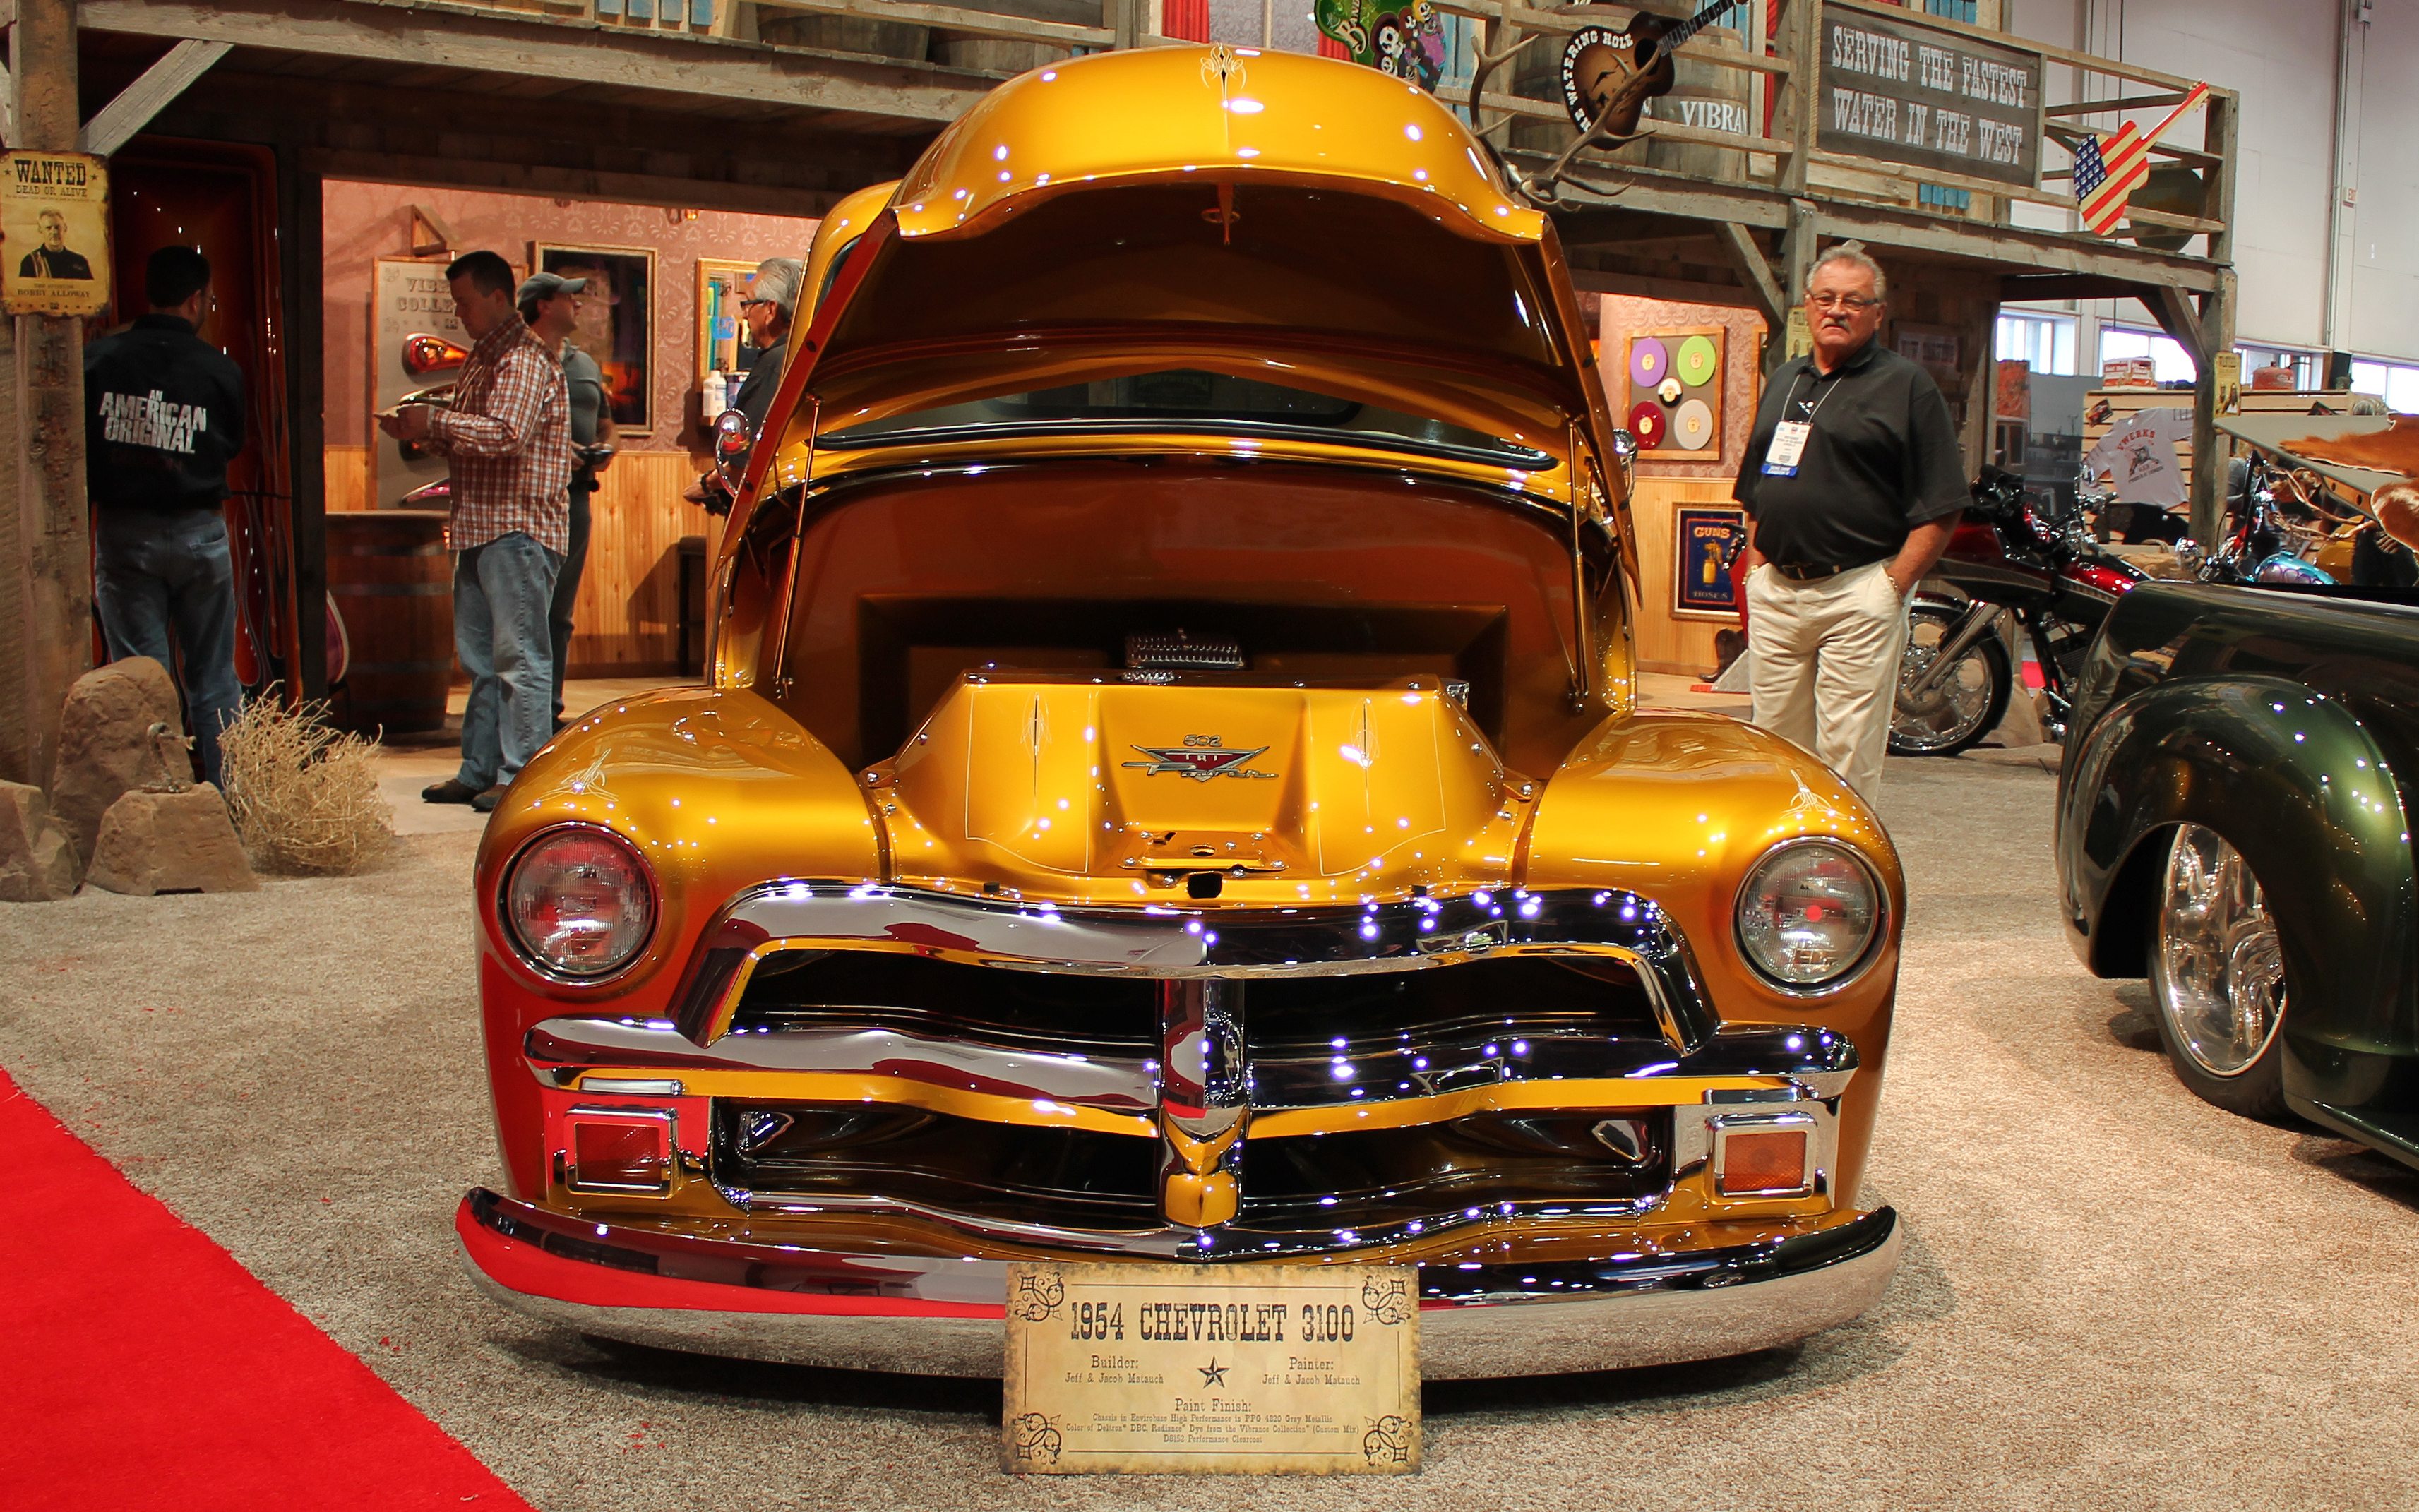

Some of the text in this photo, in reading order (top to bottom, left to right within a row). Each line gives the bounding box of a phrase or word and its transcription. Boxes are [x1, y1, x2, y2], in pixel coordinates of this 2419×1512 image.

[1563, 30, 1599, 107] WATERING
[1603, 31, 1634, 49] HOLE
[1832, 25, 2028, 109] SERVING THE FASTEST
[1833, 88, 2024, 165] WATER IN THE WEST
[14, 159, 86, 186] WANTED
[16, 185, 88, 197] DEAD OR ALIVE
[149, 389, 163, 402] AN
[99, 391, 207, 432] AMERICAN
[104, 416, 196, 454] ORIGINAL
[1694, 526, 1731, 539] GUNS
[1183, 734, 1222, 747] 502
[1185, 752, 1218, 762] TRI
[1071, 1302, 1354, 1342] 1954 CHEVROLET 3100
[1091, 1355, 1139, 1369] Builder:
[1289, 1357, 1334, 1370] Painter:
[1065, 1372, 1083, 1383] Jeff
[1087, 1372, 1094, 1383] &
[1099, 1373, 1123, 1383] Jacob
[1262, 1374, 1280, 1384] Jeff
[1284, 1374, 1291, 1384] &
[1296, 1374, 1320, 1385] Jacob
[1175, 1398, 1251, 1412] Paint Finish:
[1093, 1413, 1117, 1422] Chassis
[1171, 1414, 1188, 1424] High
[1190, 1414, 1231, 1422] Performance
[1066, 1423, 1084, 1432] Color
[1087, 1423, 1094, 1432] of
[1190, 1424, 1203, 1434] Dye
[1240, 1424, 1270, 1433] Vibrance
[1313, 1425, 1339, 1434] (Custom
[1343, 1425, 1359, 1434] Mix)
[1188, 1434, 1229, 1444] Performance
[1232, 1435, 1262, 1444] Clearcoat
